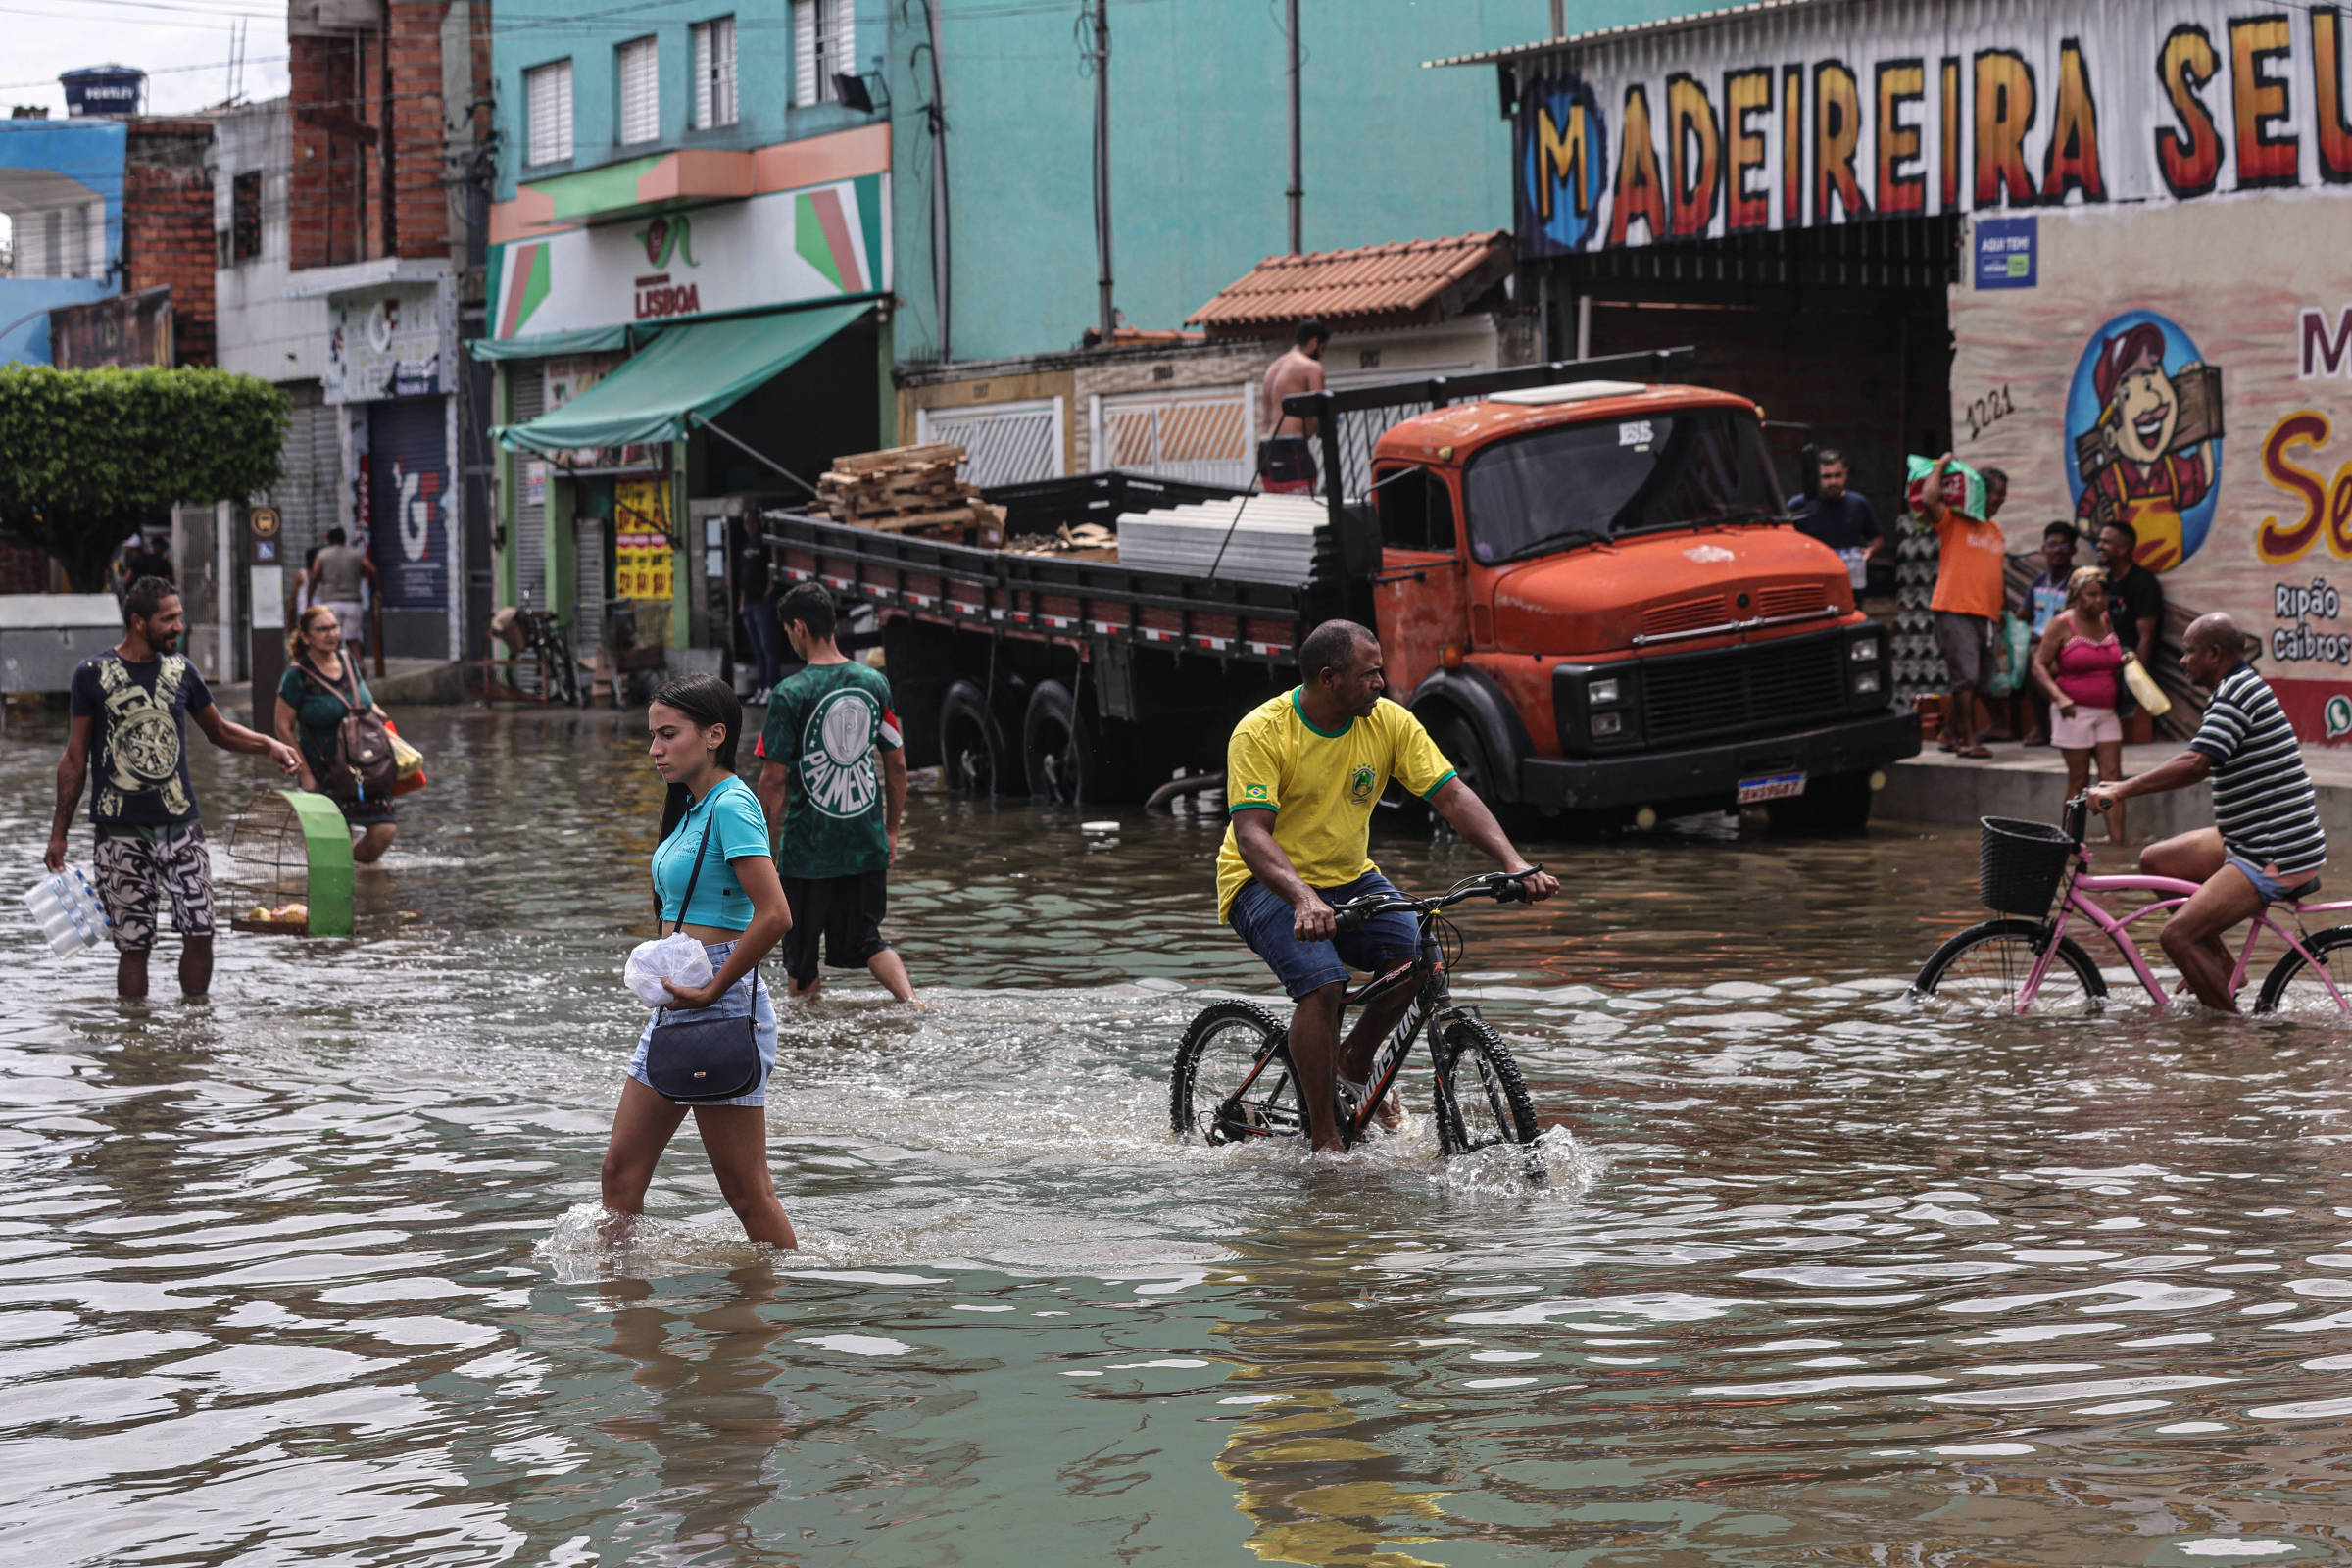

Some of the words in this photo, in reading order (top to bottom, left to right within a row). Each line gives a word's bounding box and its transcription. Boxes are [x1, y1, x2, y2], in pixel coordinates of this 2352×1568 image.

[1534, 37, 2107, 253] MADEIREIRA
[1981, 238, 2005, 252] AQUI
[635, 282, 700, 318] LISBOA
[1966, 383, 2015, 441] 1221
[2272, 623, 2351, 666] Caibros
[1355, 995, 1422, 1117] HOUSTON
